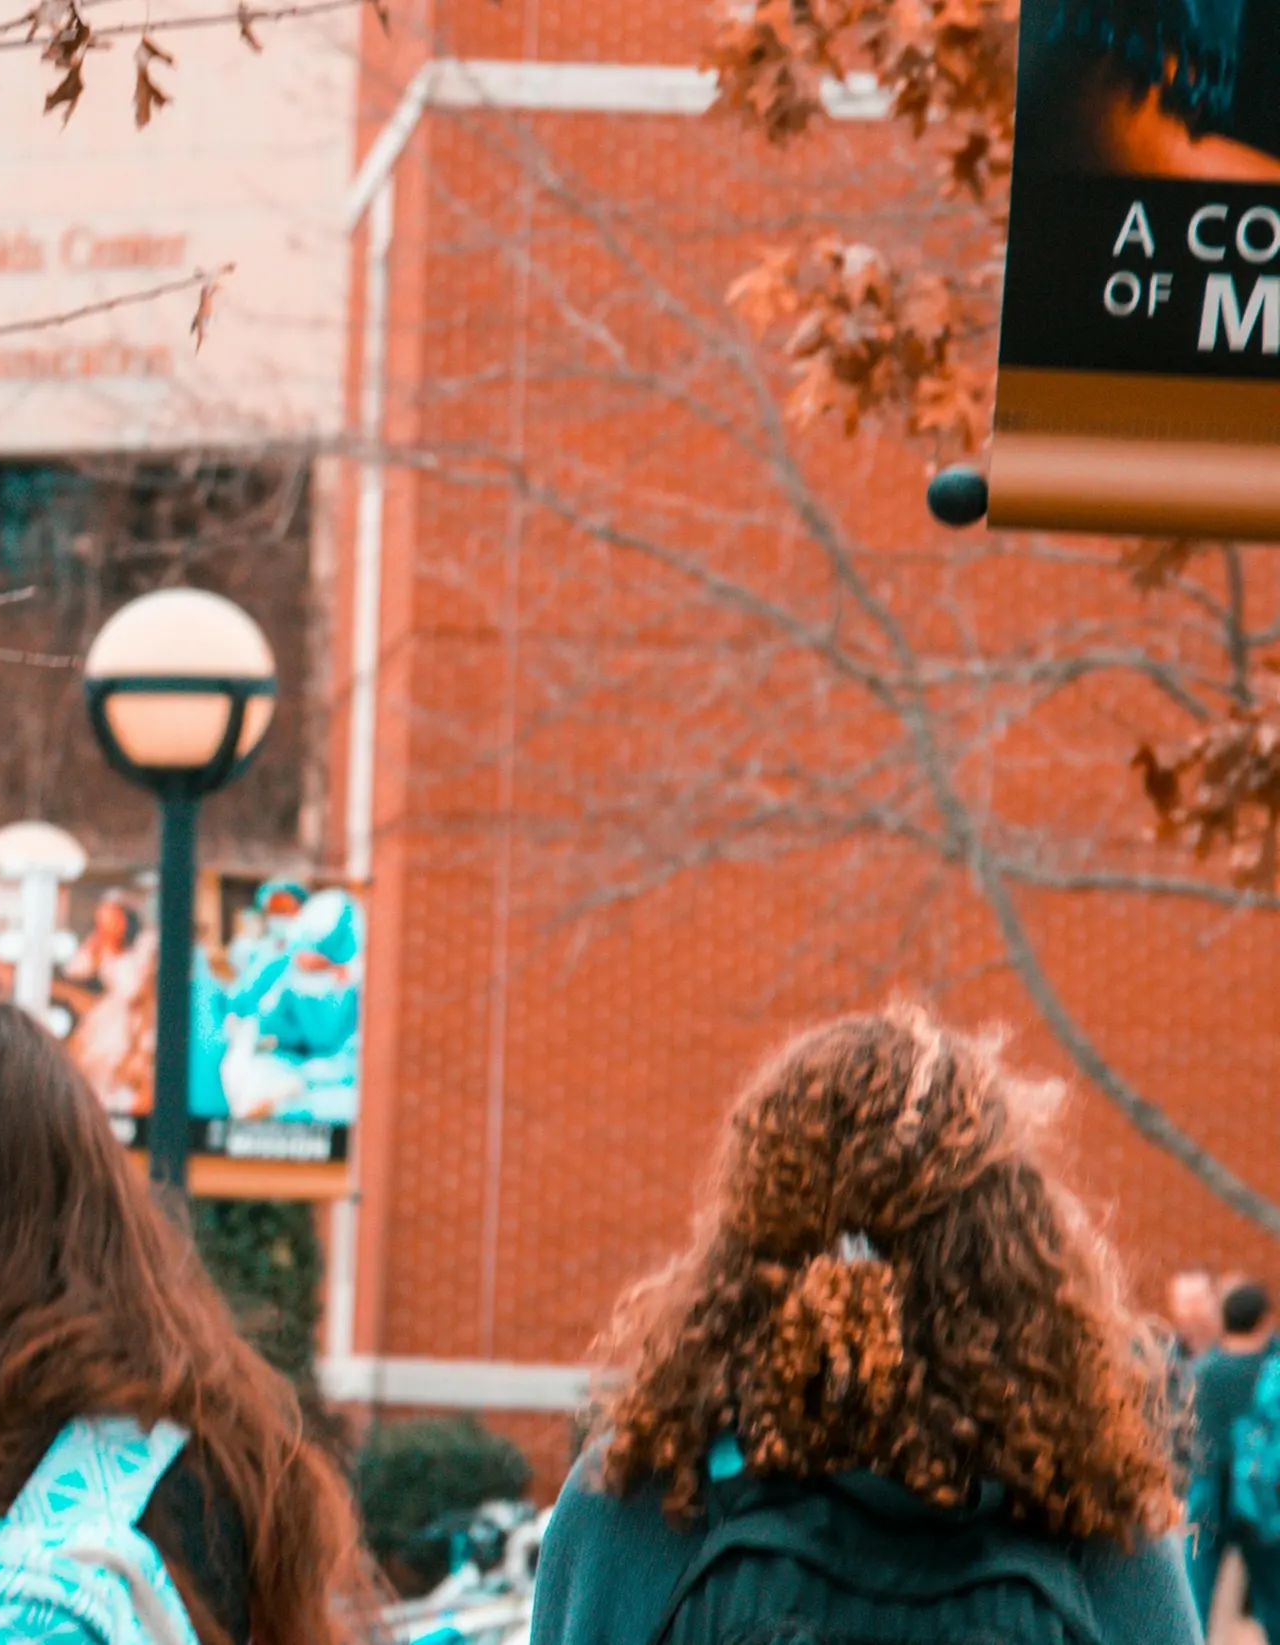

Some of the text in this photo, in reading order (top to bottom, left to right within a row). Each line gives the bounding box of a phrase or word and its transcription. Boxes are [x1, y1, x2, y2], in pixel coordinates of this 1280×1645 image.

[1111, 200, 1280, 263] A CO
[1103, 270, 1280, 354] OF M
